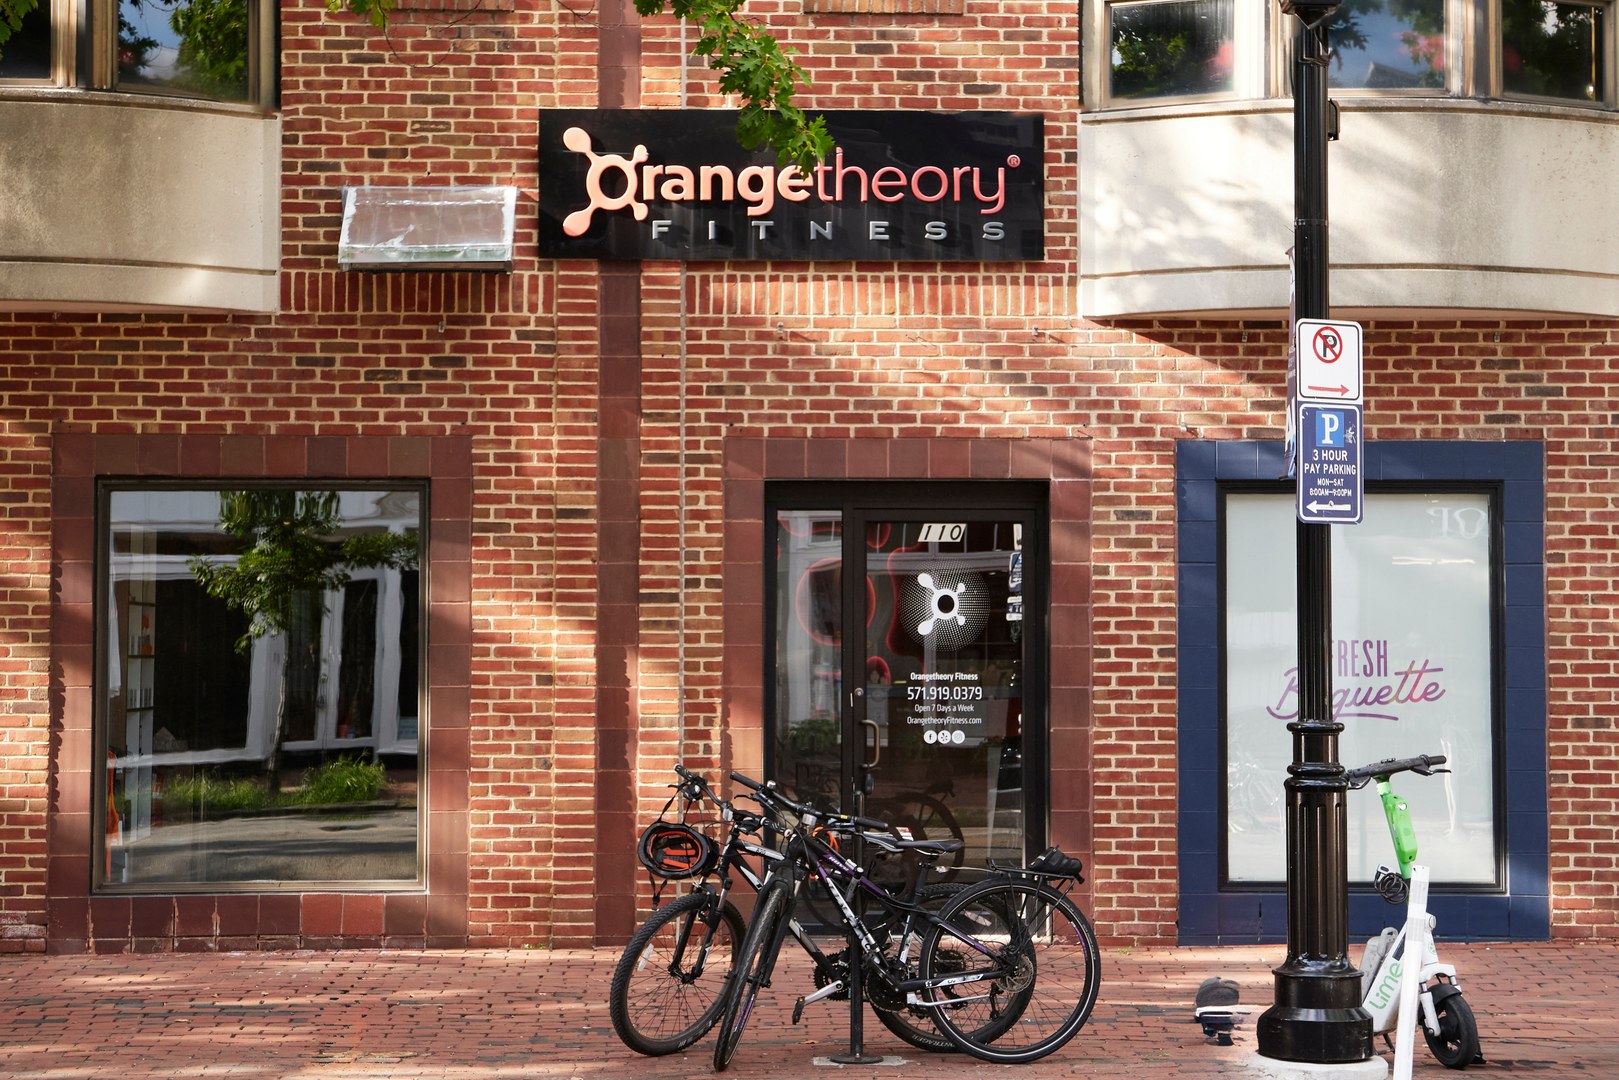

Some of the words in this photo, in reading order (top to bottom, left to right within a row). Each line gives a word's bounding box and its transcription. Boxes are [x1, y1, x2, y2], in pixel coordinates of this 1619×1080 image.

[652, 220, 1005, 240] FITNESS
[1321, 413, 1340, 445] P
[1312, 450, 1319, 461] 3
[1322, 450, 1348, 462] HOUR
[1304, 463, 1321, 474] PAY
[1323, 464, 1356, 475] PARKING
[924, 524, 962, 541] 110
[1332, 639, 1388, 677] RESH
[910, 672, 954, 682] Orangetheory
[955, 672, 978, 681] Fitness
[907, 686, 983, 700] 571.919.0379
[914, 704, 930, 713] Open
[931, 704, 936, 712] 7
[936, 704, 951, 713] Days
[957, 704, 974, 712] Week
[907, 716, 982, 726] OrangetheoryFitness.com
